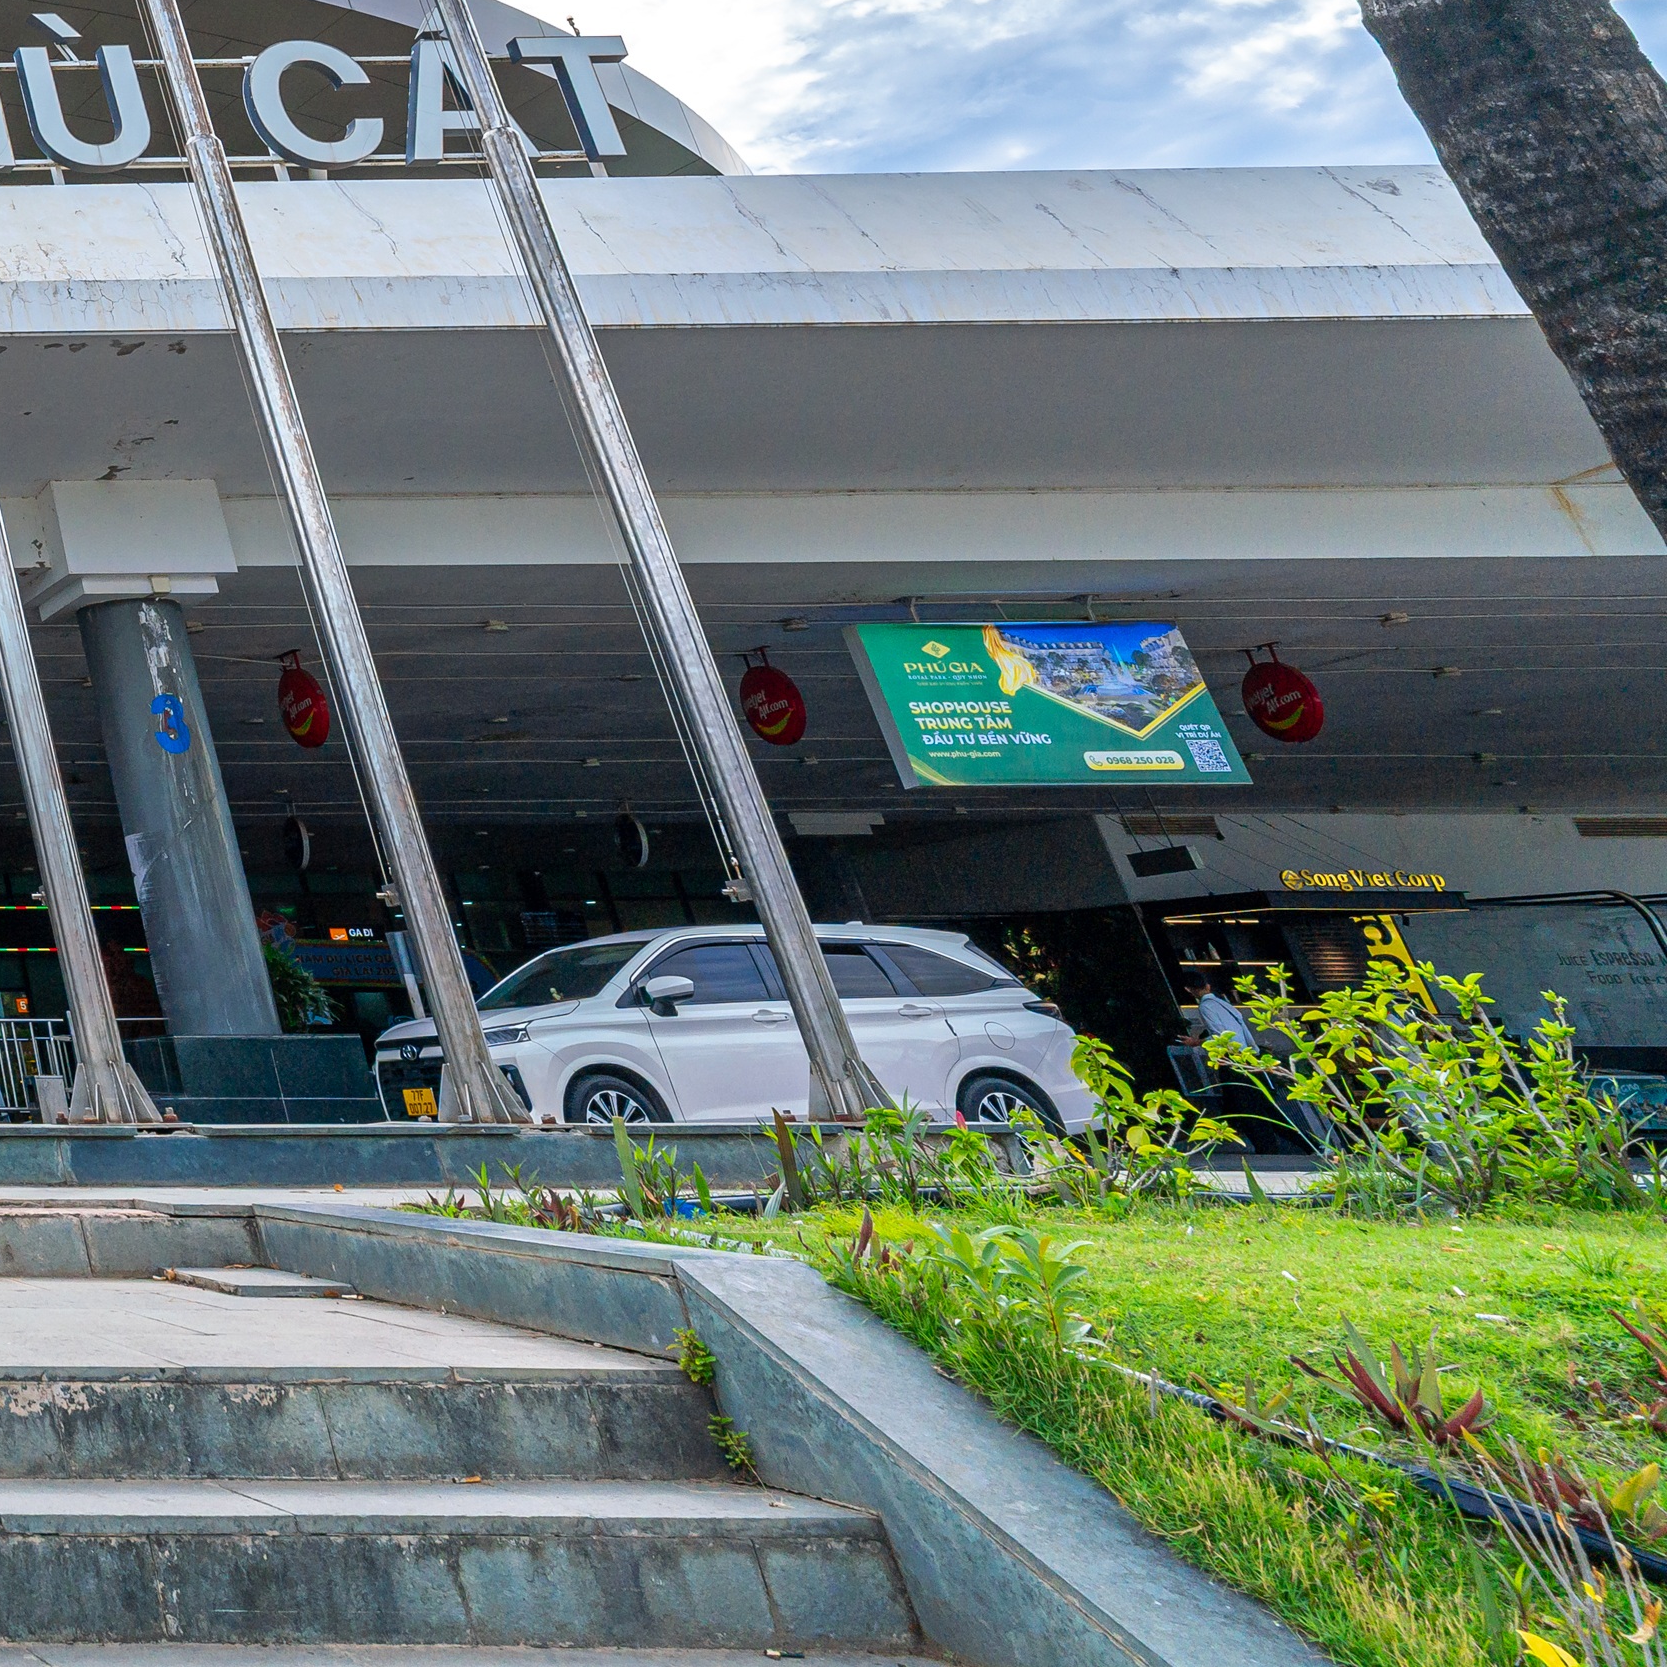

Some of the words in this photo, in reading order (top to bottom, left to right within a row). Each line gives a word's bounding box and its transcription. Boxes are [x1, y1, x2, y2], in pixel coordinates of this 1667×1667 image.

[243, 7, 628, 170] CÁT
[903, 661, 946, 673] PHÚ
[948, 662, 985, 673] GIA
[908, 701, 1013, 715] SHOPHOUSE
[151, 693, 191, 754] 3
[914, 717, 973, 730] TRUNG
[974, 714, 1013, 730] TÂM
[954, 733, 976, 745] TƯ
[1008, 731, 1052, 745] VỮNG
[928, 749, 1001, 759] www.phu-gia.com
[1106, 756, 1132, 765] 0968
[1134, 756, 1153, 765] 250
[1155, 756, 1175, 765] 028
[1300, 869, 1354, 892] Song
[1348, 869, 1395, 888] Viet
[1394, 870, 1447, 893] Corp
[348, 928, 362, 937] GA
